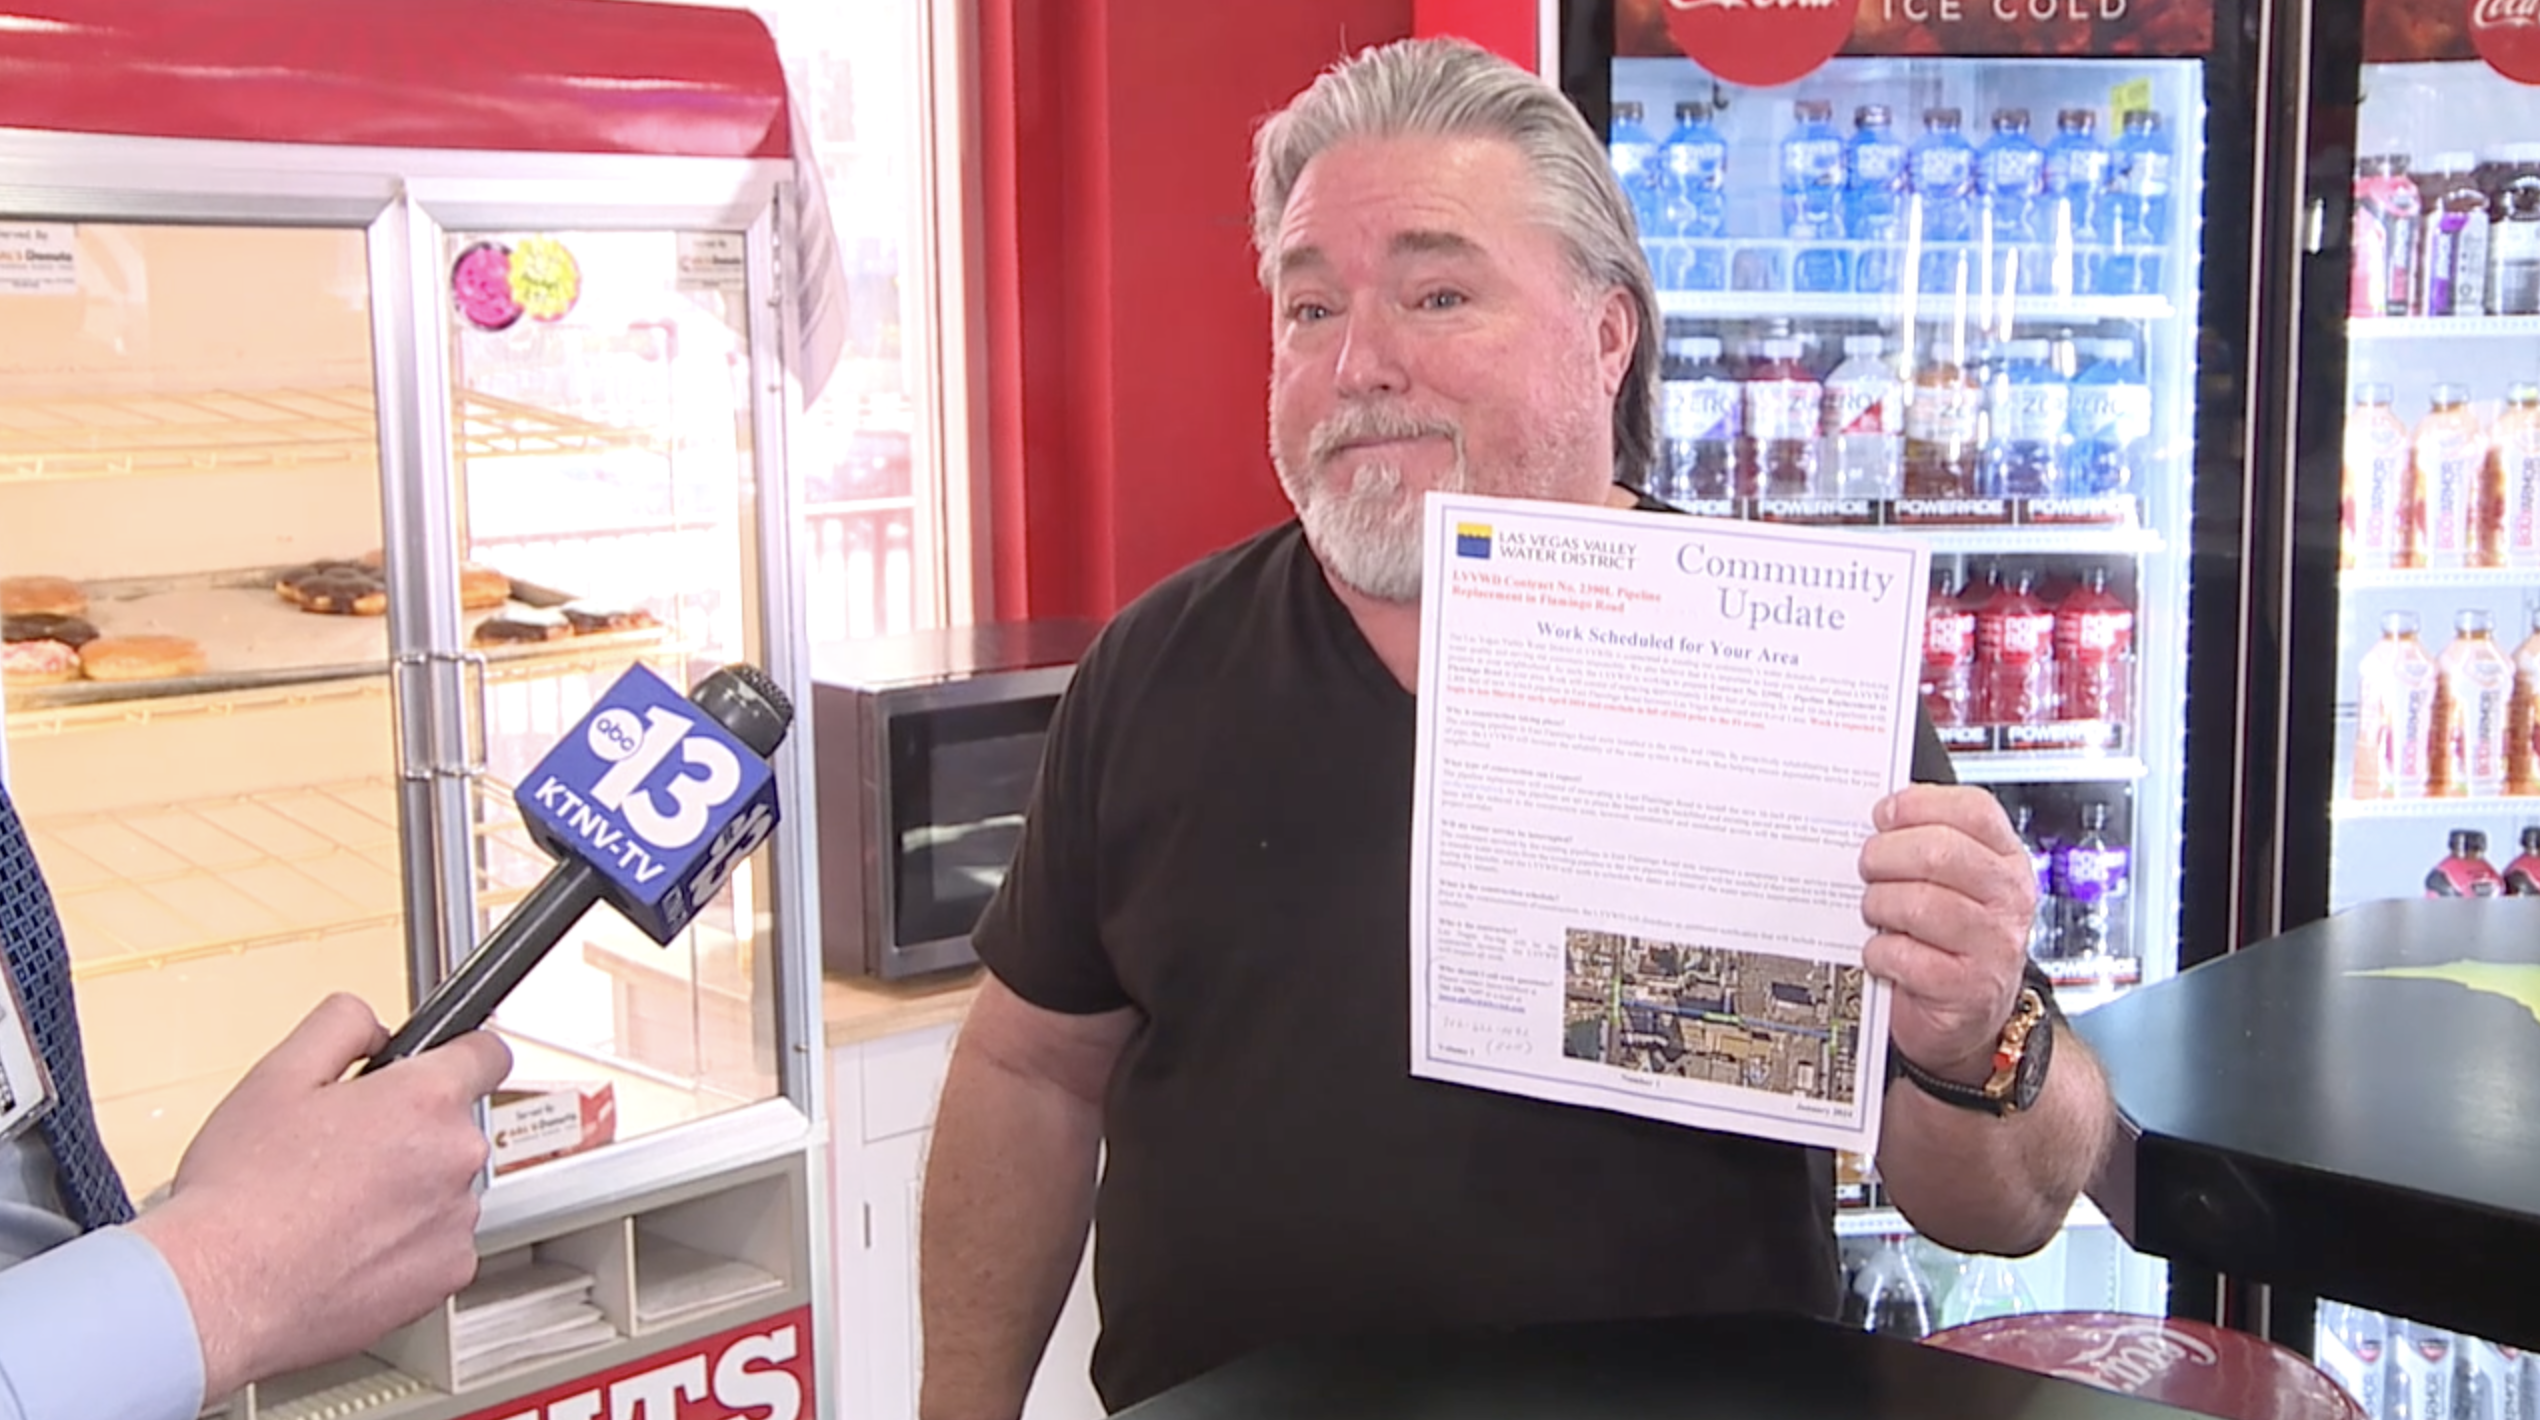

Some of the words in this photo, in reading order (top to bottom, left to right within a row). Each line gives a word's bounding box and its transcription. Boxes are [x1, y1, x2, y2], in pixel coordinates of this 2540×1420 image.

[1499, 529, 1522, 544] LAS
[1529, 532, 1578, 550] VEGAS
[1583, 538, 1636, 556] VALLEY
[1500, 544, 1556, 563] WATER
[1561, 549, 1635, 571] DISTRICT
[1504, 574, 1554, 591] Contract
[1617, 587, 1661, 605] Pipeline
[1676, 541, 1895, 602] Community
[1452, 582, 1521, 605] Replacement
[1526, 591, 1536, 604] in
[1540, 592, 1592, 613] Flamingo
[1595, 599, 1624, 614] Road
[1717, 587, 1847, 631] Update
[1537, 619, 1583, 639] Work
[1588, 625, 1665, 649] Scheduled
[1679, 636, 1704, 654] for
[1710, 640, 1752, 659] Your
[1757, 645, 1800, 665] Area
[597, 718, 635, 752] abc
[590, 705, 741, 849] 13
[534, 776, 666, 884] KTNV-TV
